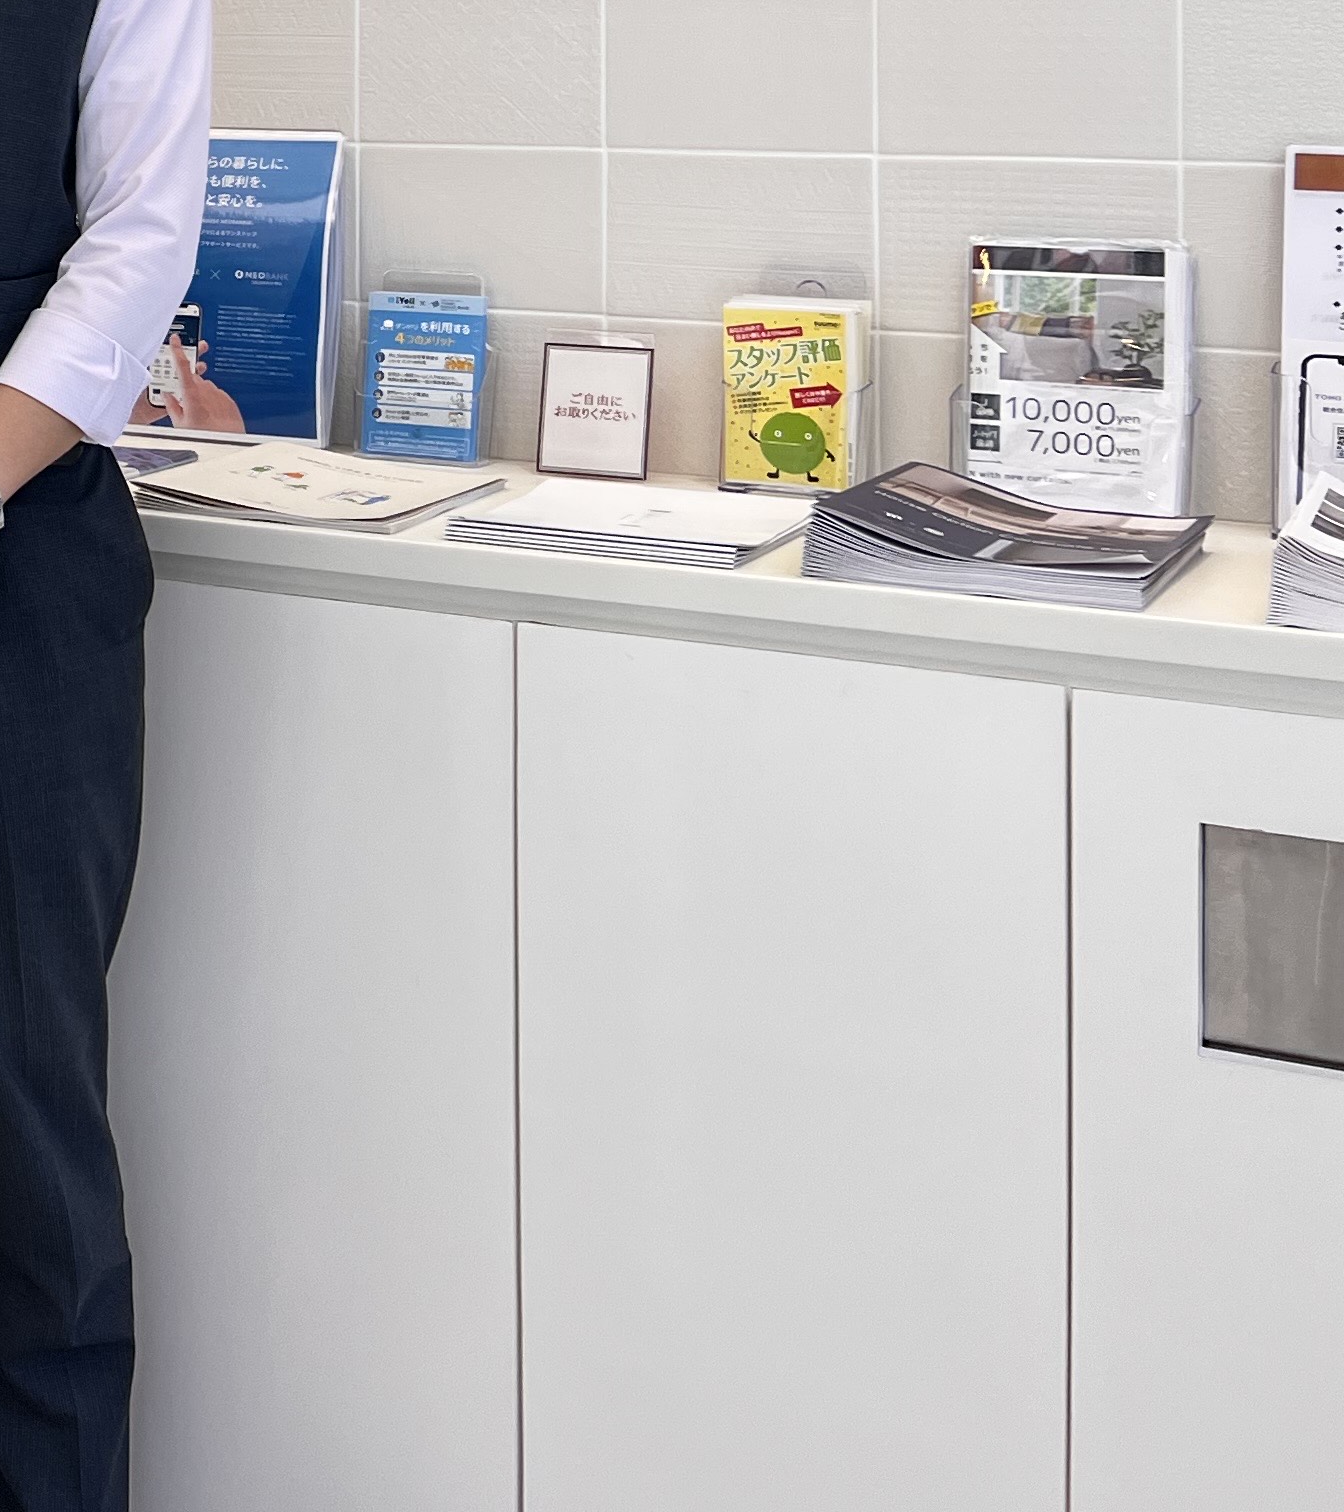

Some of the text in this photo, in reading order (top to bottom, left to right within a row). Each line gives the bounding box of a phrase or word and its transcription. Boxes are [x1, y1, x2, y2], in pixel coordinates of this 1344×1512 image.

[206, 174, 266, 189] も便利を、
[206, 193, 262, 208] と安心を。
[727, 338, 842, 370] スタッフ評価
[730, 366, 810, 390] アンケート
[569, 392, 623, 406] ご自由に
[554, 405, 636, 421] お取りください
[979, 471, 1002, 479] with
